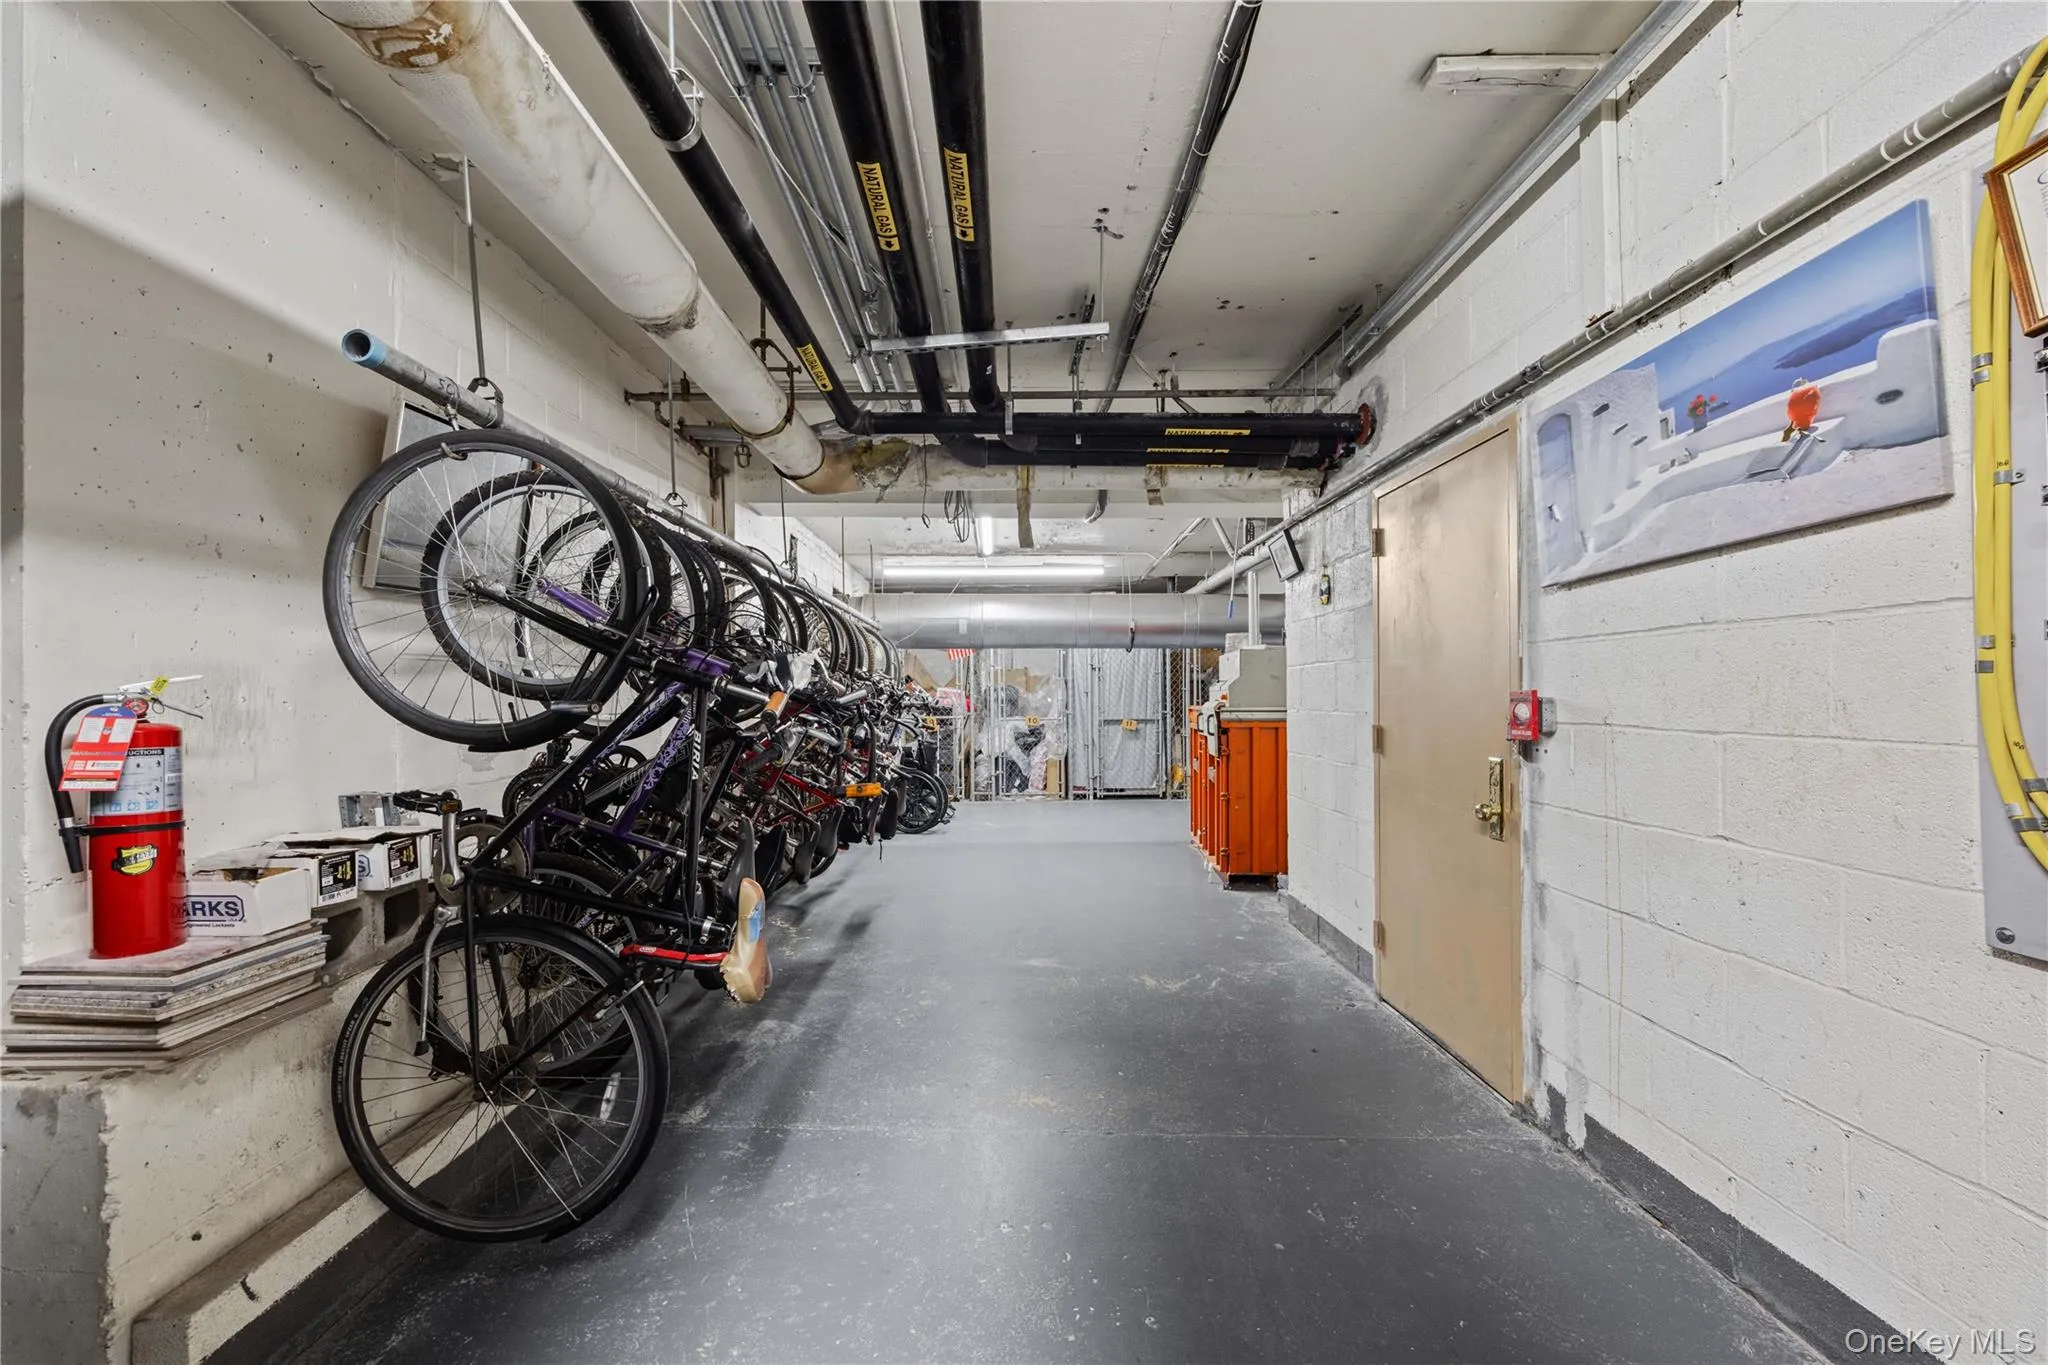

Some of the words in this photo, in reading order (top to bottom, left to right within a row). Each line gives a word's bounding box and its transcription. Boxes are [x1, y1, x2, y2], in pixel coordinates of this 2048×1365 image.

[862, 167, 887, 213] NATURAL
[876, 215, 892, 234] GAS
[949, 155, 966, 201] NATURAL
[955, 205, 969, 224] GAS
[692, 730, 702, 780] BIRIA
[173, 901, 240, 917] ARKS
